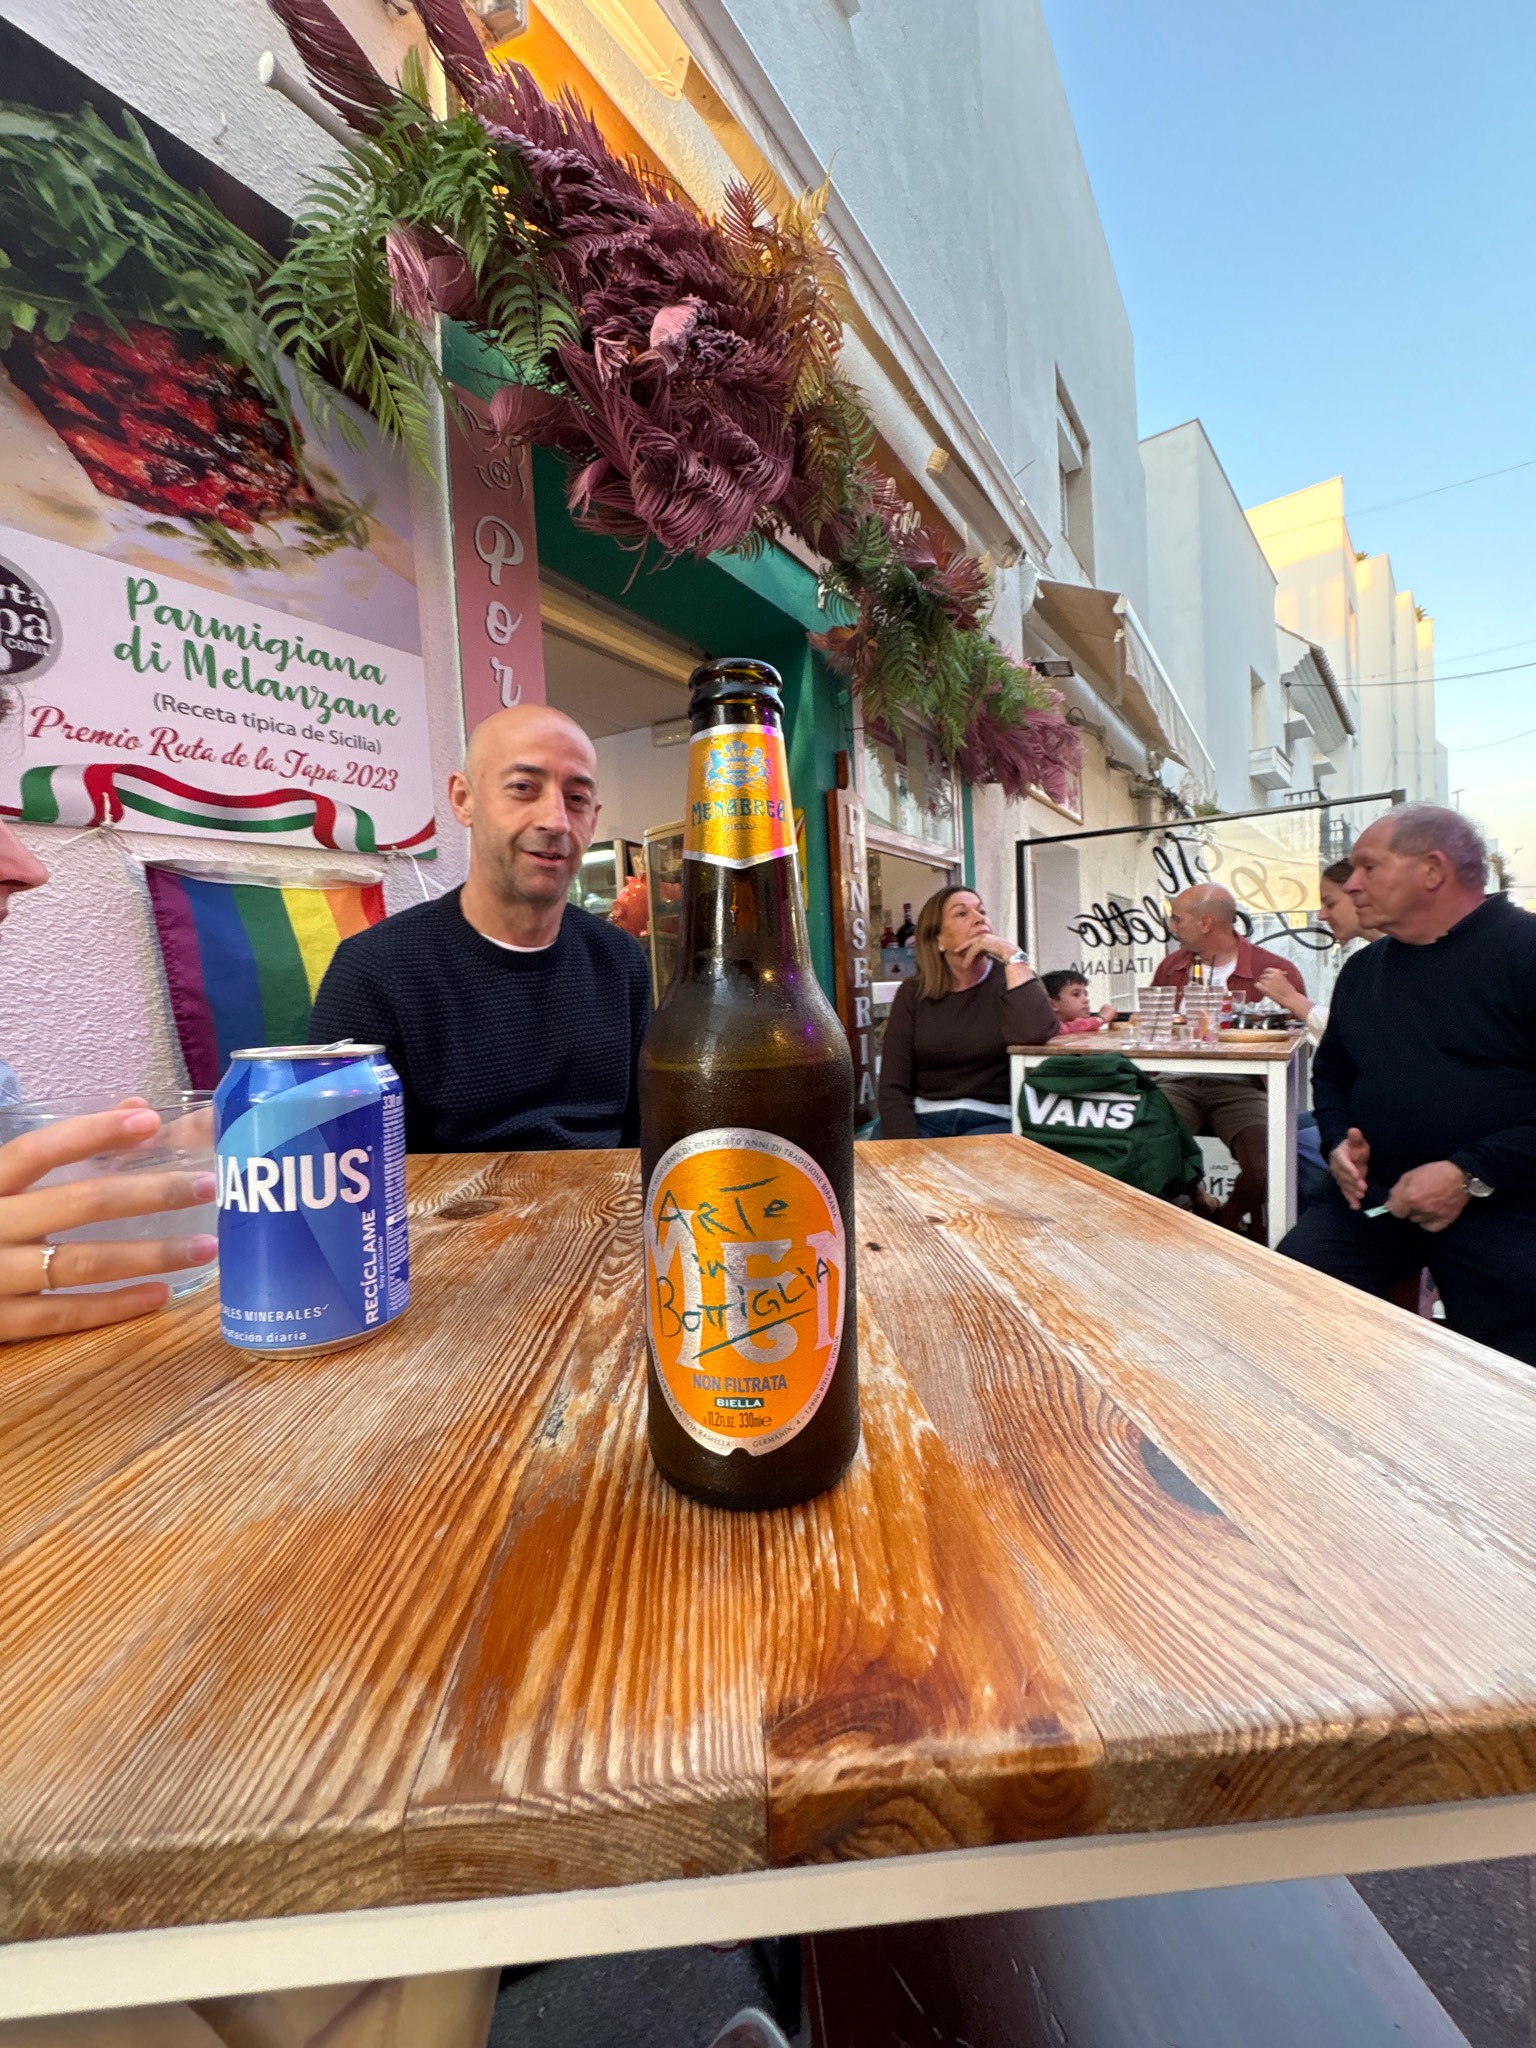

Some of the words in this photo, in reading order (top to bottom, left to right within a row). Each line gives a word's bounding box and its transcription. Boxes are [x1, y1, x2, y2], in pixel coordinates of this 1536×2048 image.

[126, 576, 387, 685] Parmigiana
[114, 625, 172, 673] di
[183, 639, 400, 726] Melanzane
[153, 692, 236, 724] (Receta
[242, 712, 296, 736] típica
[301, 724, 325, 742] de
[329, 729, 382, 755] Sicilia)
[27, 705, 144, 750] Premio
[148, 726, 217, 763] Ruta
[221, 741, 250, 768] de
[254, 746, 277, 772] la
[279, 749, 339, 787] Tapa
[342, 761, 399, 792] 2023
[691, 797, 785, 826] MENABREA
[846, 803, 876, 1104] PINSERIA
[1024, 1083, 1138, 1130] VANS
[744, 1139, 769, 1150] ANNI
[771, 1143, 781, 1153] DI
[783, 1148, 824, 1183] TRADIZIONE
[360, 1208, 379, 1325] RECÍCLAME
[244, 1306, 323, 1322] MINERALES
[266, 1330, 307, 1343] diaria
[692, 1373, 721, 1392] NON
[724, 1374, 788, 1393] FILTRATA
[716, 1398, 762, 1408] BIELLA
